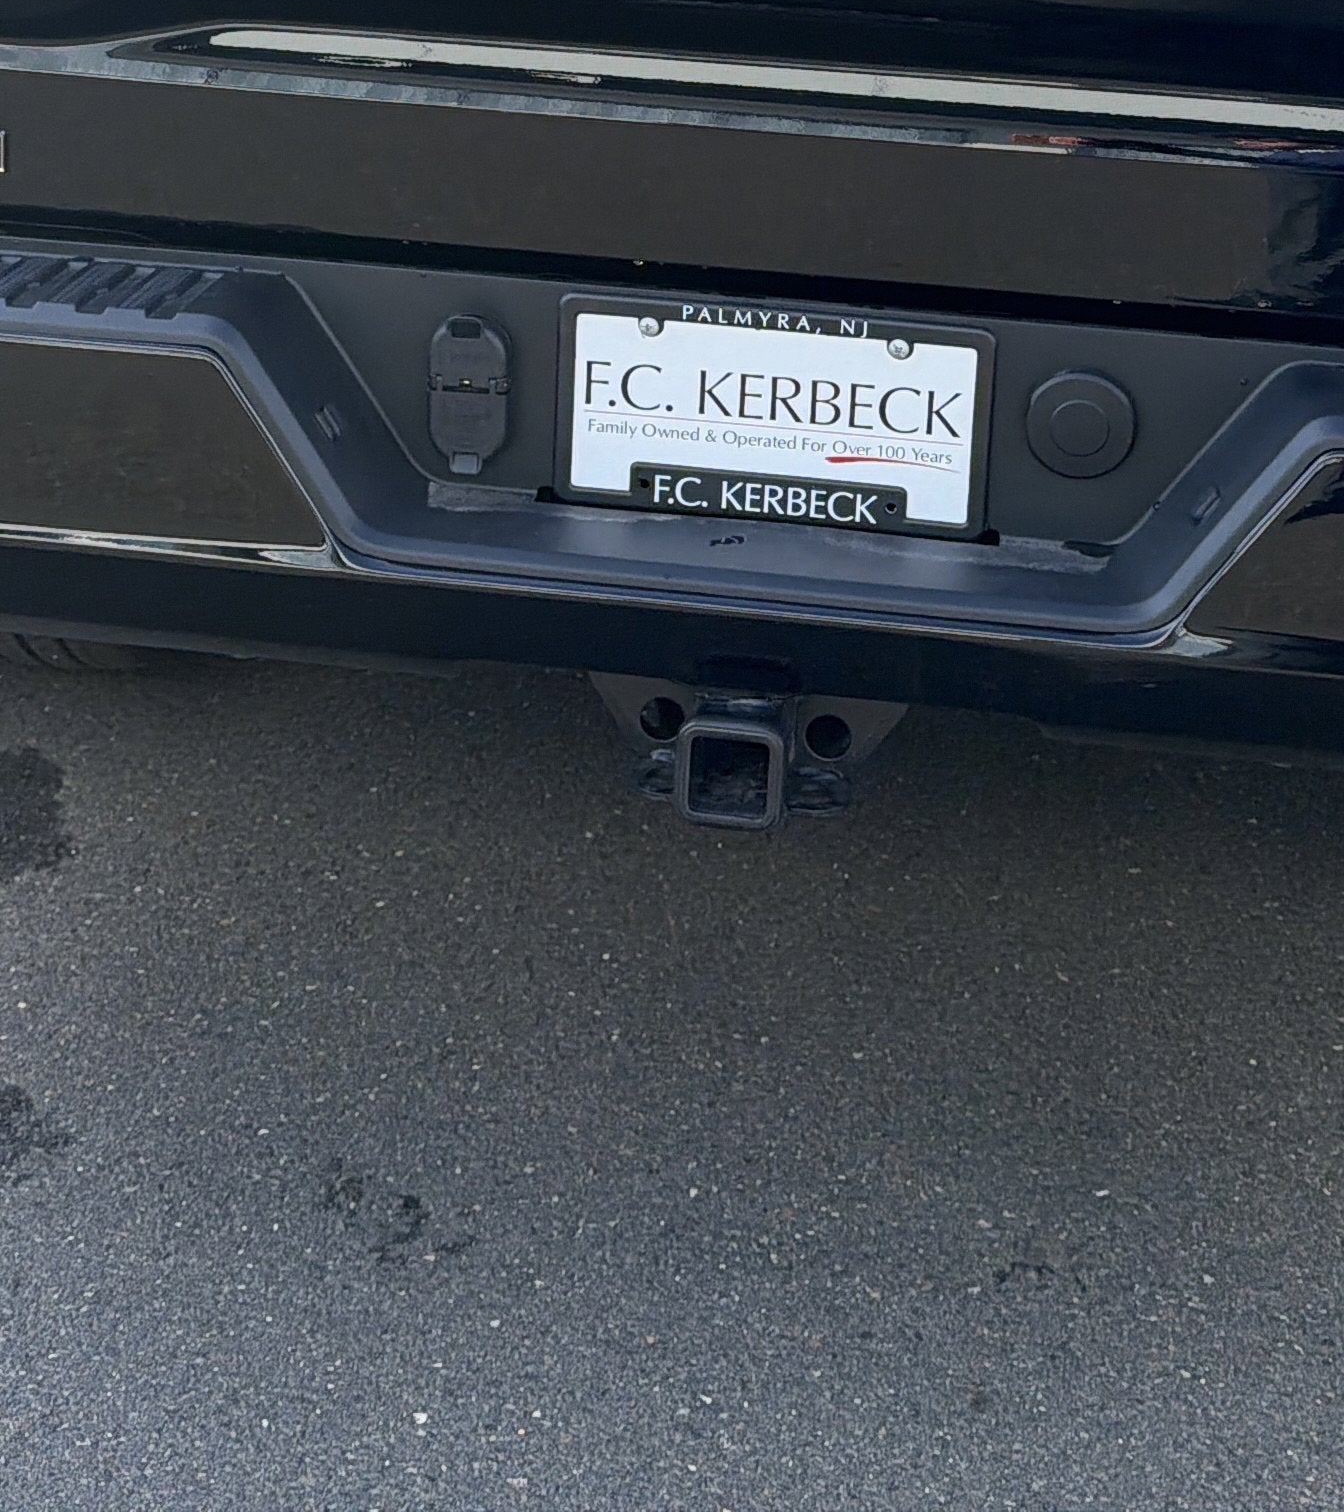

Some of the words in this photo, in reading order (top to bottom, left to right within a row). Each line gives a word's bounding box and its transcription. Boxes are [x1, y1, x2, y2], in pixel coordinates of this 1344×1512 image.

[682, 304, 822, 335] PALMYRA,
[840, 317, 871, 338] NJ
[584, 359, 674, 414] F.C.
[697, 368, 962, 439] KERBECK
[587, 418, 638, 440] Family
[642, 422, 701, 443] Owned
[705, 428, 718, 443] &
[722, 430, 797, 453] Operated
[802, 436, 828, 454] For
[832, 439, 873, 458] Over
[877, 444, 906, 461] 100
[911, 446, 954, 466] Years
[652, 474, 708, 509] F.C.
[720, 480, 878, 525] KERBECK
